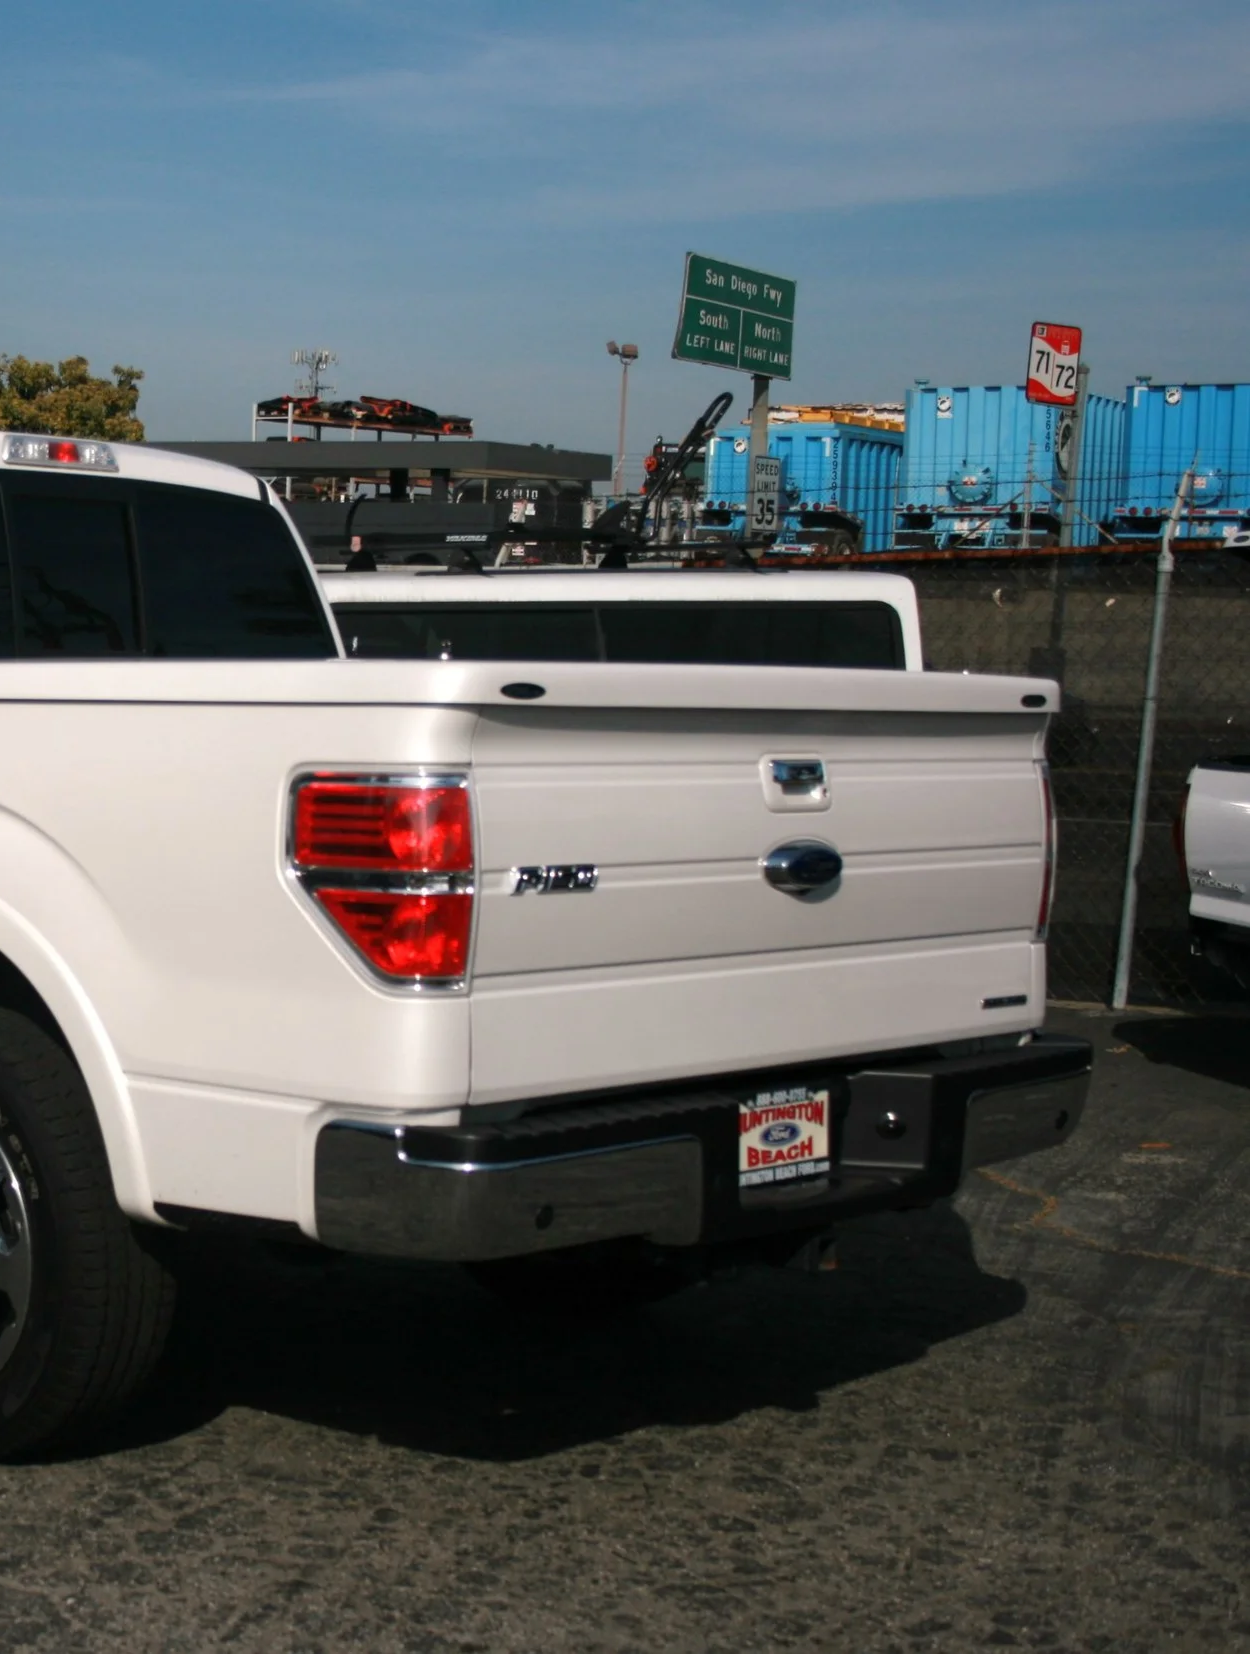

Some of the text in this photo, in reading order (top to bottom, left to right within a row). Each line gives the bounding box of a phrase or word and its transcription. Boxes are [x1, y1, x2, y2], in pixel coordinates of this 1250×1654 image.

[705, 269, 783, 307] San Diego Fwy
[699, 309, 729, 331] South
[754, 323, 782, 342] North
[686, 334, 735, 356] LEFT LANE
[744, 346, 789, 366] RIGHT LANE
[1035, 350, 1050, 374] 71
[1055, 364, 1075, 389] 72
[1044, 406, 1052, 453] 5646
[755, 462, 779, 476] SPEED
[756, 480, 776, 493] LIMIT
[755, 498, 775, 525] 35
[747, 1135, 813, 1168] BEACH
